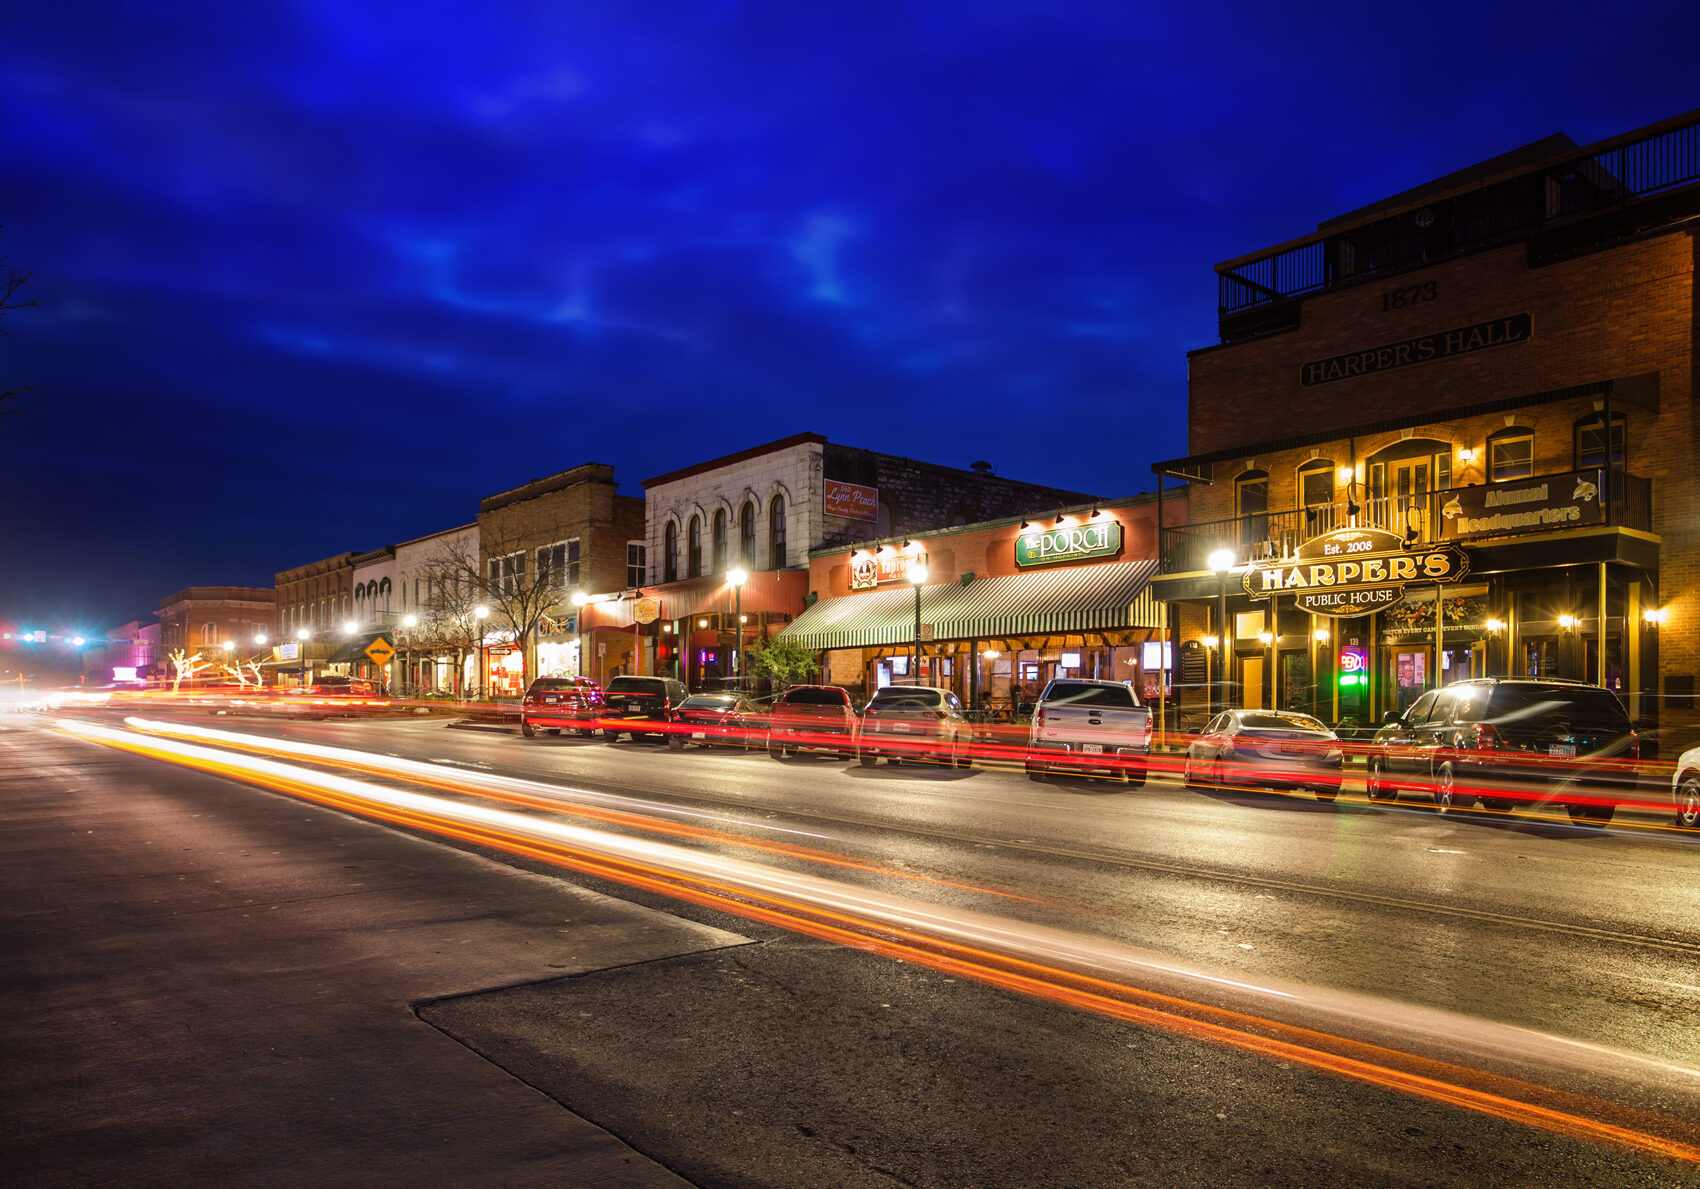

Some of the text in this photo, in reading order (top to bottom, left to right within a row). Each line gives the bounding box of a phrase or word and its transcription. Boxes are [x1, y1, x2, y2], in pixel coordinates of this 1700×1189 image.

[1381, 281, 1438, 312] 1873
[1308, 320, 1523, 384] HARPER'S HALL
[827, 487, 876, 507] Lynn Peach
[1457, 506, 1580, 534] Headquarters
[1039, 526, 1109, 557] PORCH
[1324, 541, 1372, 555] Est. 2008
[1261, 554, 1451, 590] HARPER'S
[1305, 590, 1393, 607] PUBLIC HOUSE
